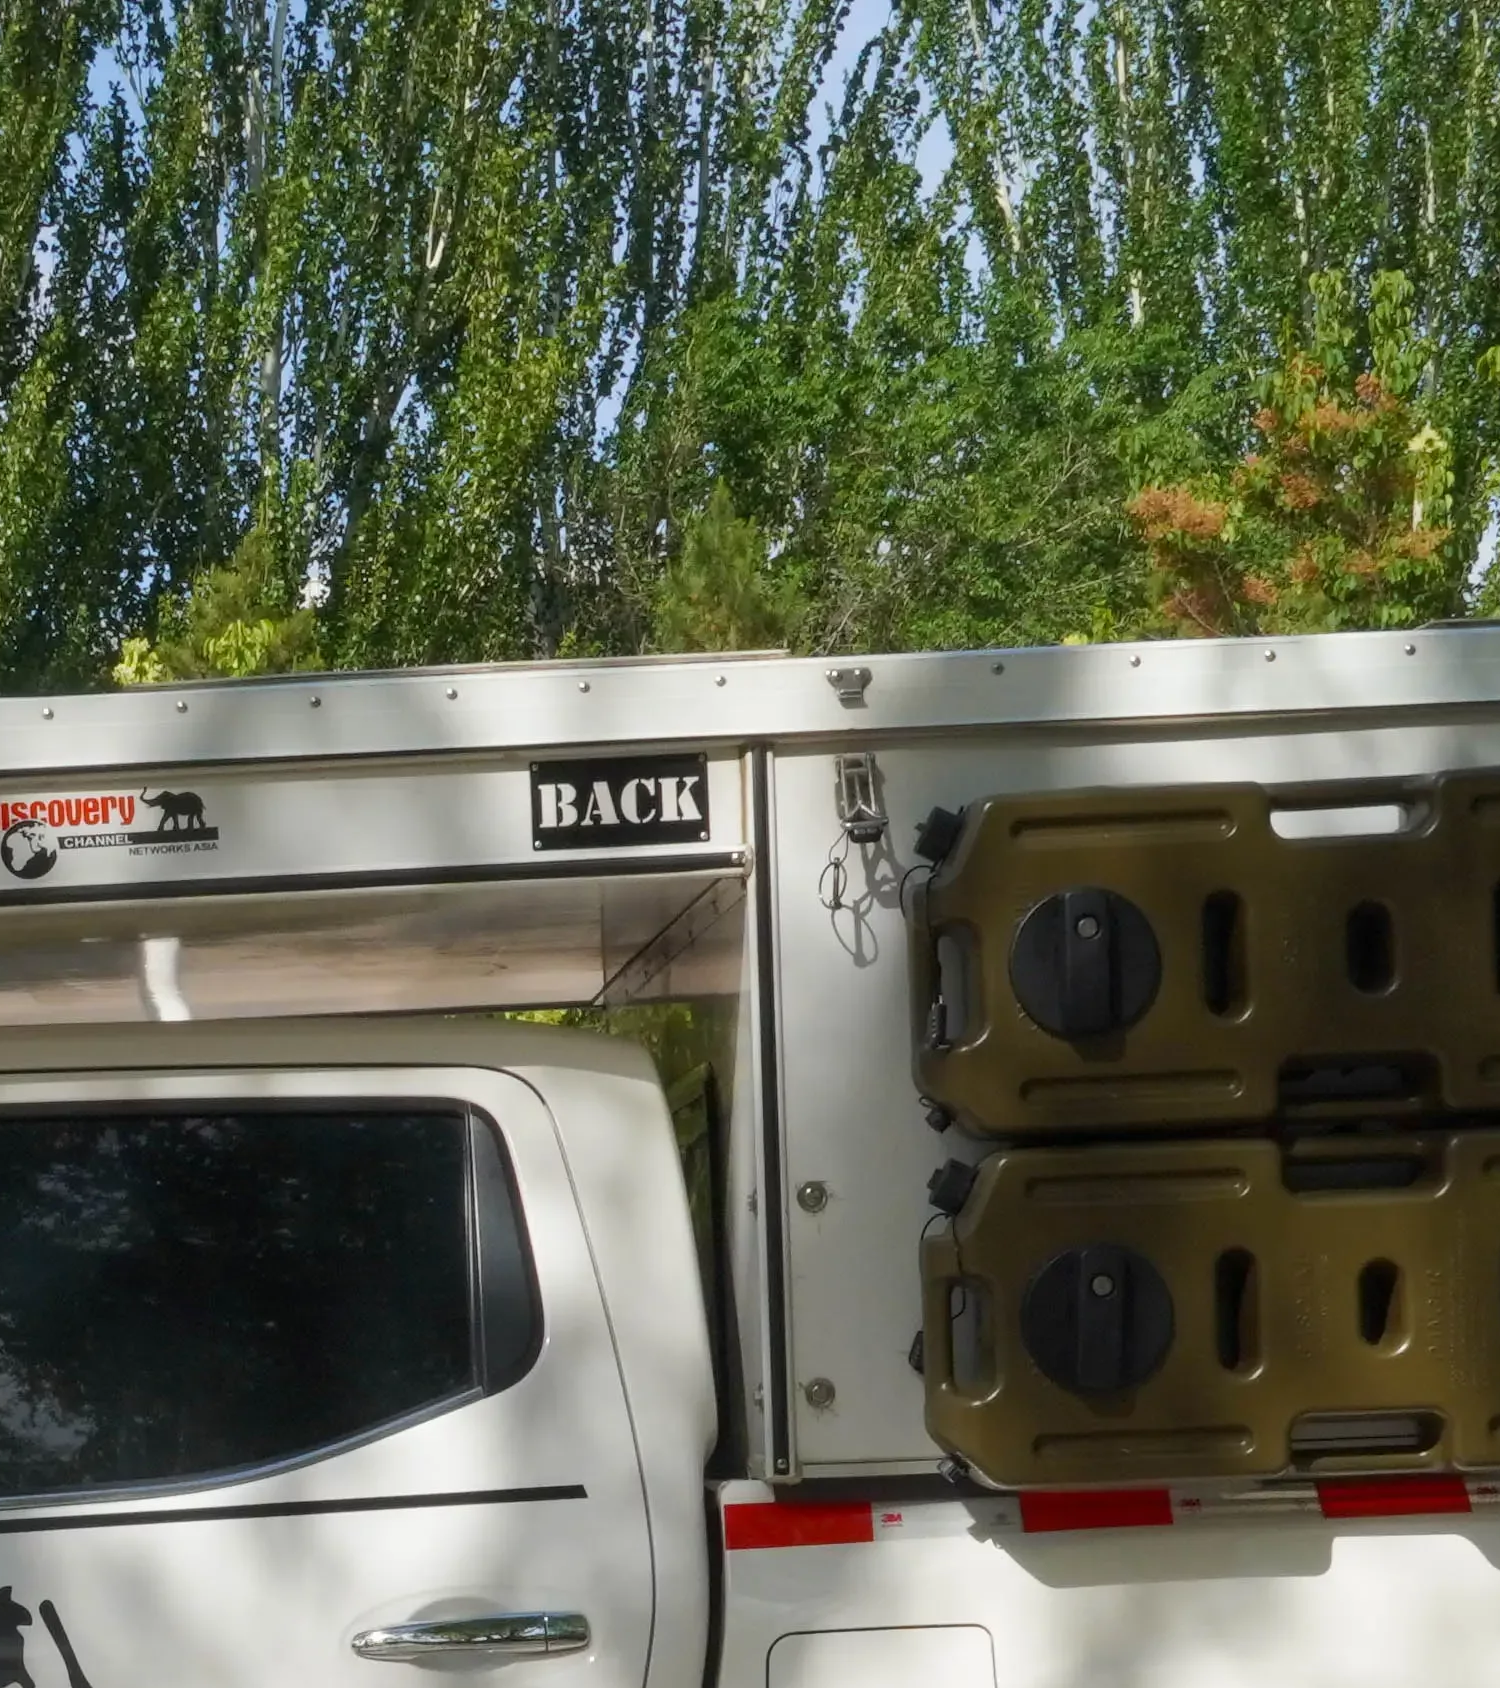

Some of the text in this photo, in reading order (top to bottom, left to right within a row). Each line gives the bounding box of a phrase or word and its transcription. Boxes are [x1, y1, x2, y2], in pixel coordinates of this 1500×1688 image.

[537, 775, 702, 829] BACK
[63, 834, 134, 849] CHANNEL
[128, 841, 219, 857] NETWORKS ASIA
